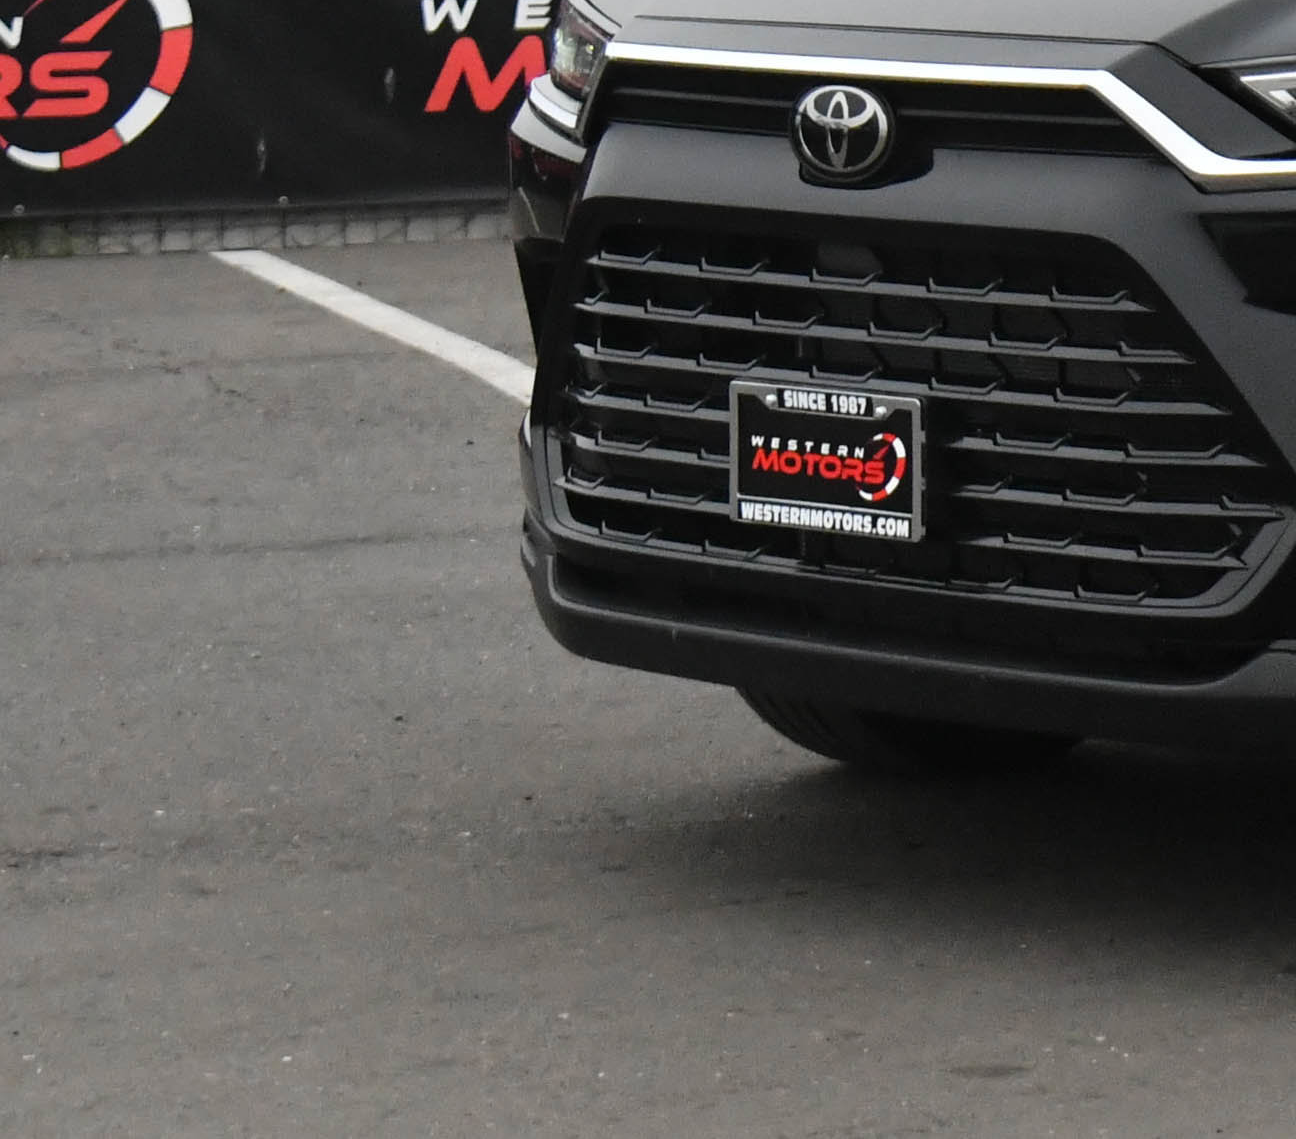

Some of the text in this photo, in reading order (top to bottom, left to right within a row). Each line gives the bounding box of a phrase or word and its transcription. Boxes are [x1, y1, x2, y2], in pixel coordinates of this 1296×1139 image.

[783, 389, 827, 412] SINCE
[751, 434, 865, 459] WESTERN
[752, 447, 885, 485] MOTORS
[740, 502, 909, 537] WESTERNMOTORS.COM
